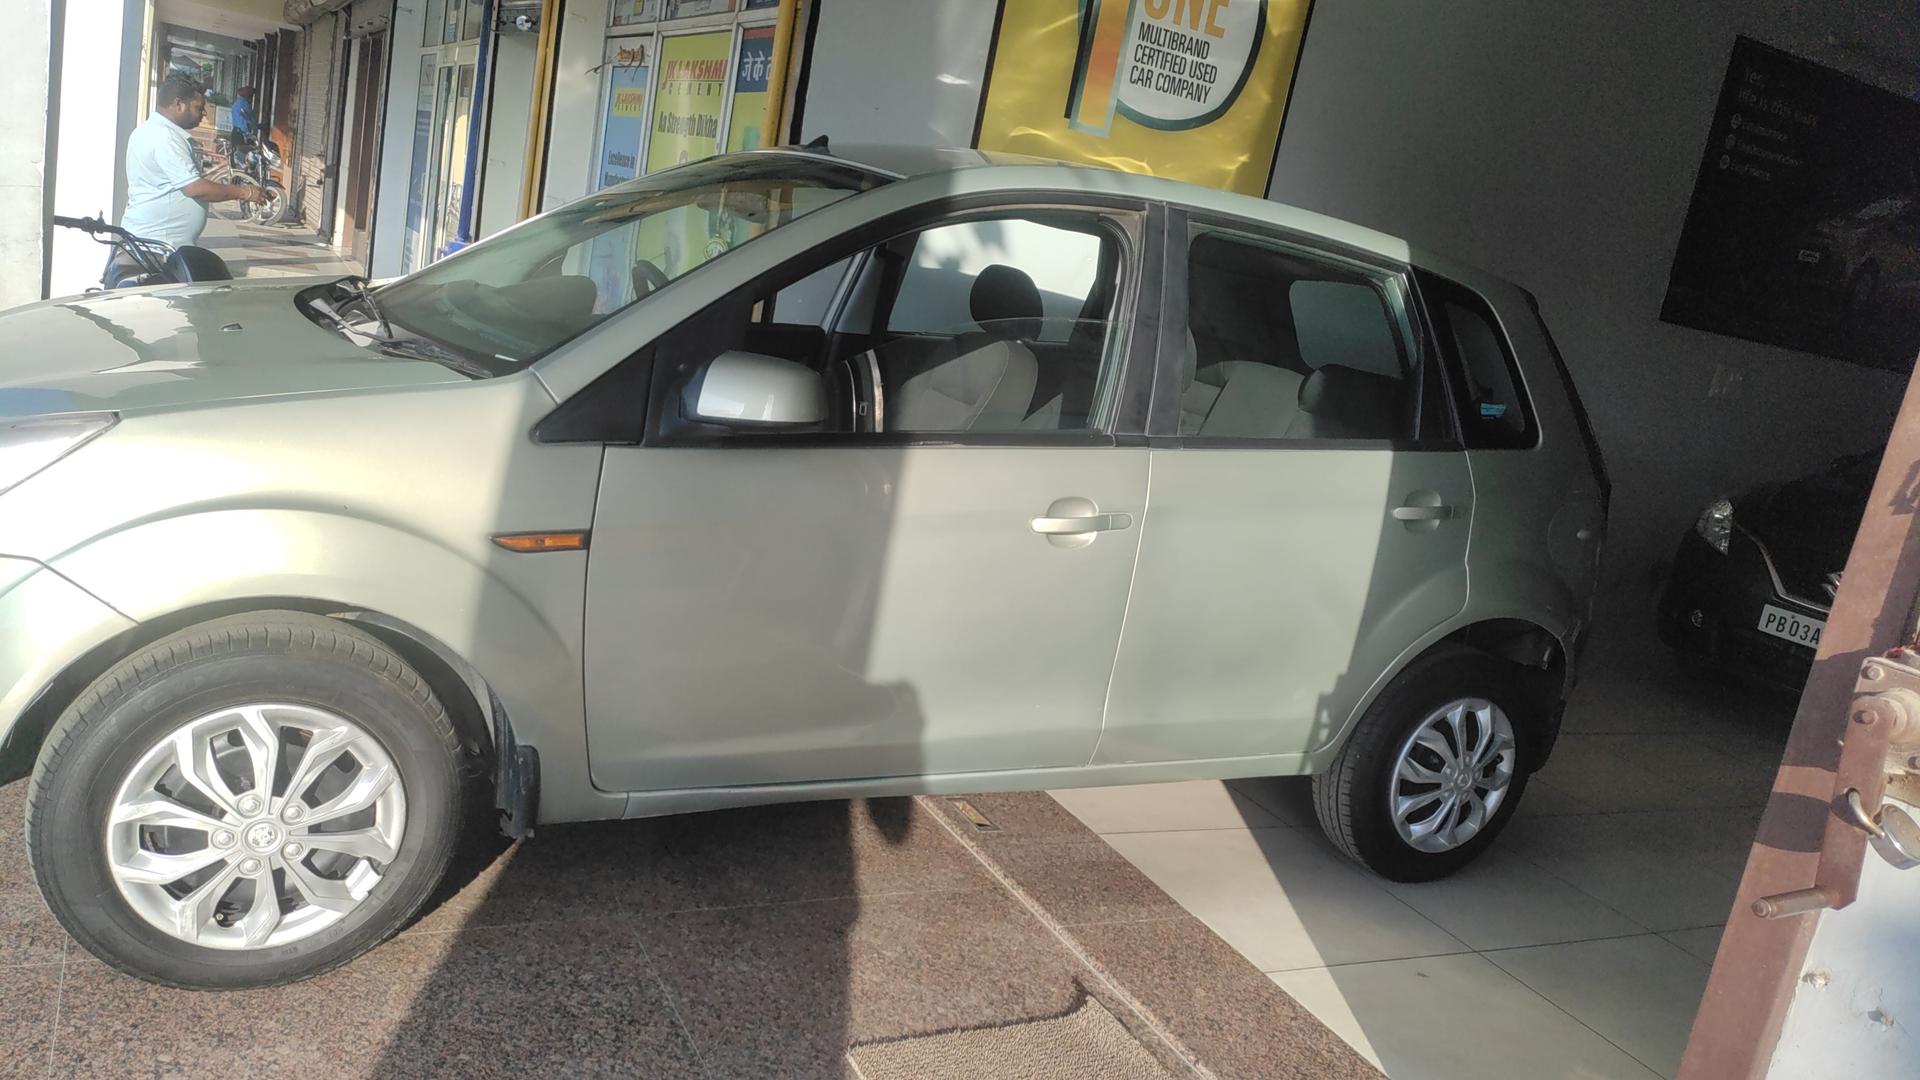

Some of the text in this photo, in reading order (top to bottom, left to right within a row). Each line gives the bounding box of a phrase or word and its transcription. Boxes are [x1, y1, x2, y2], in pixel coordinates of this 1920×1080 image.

[1137, 21, 1210, 60] MULTIBRAND
[1134, 44, 1217, 84] CERTIFIED USED
[668, 82, 723, 96] CEMENT
[1130, 65, 1212, 105] CAR COMPANY
